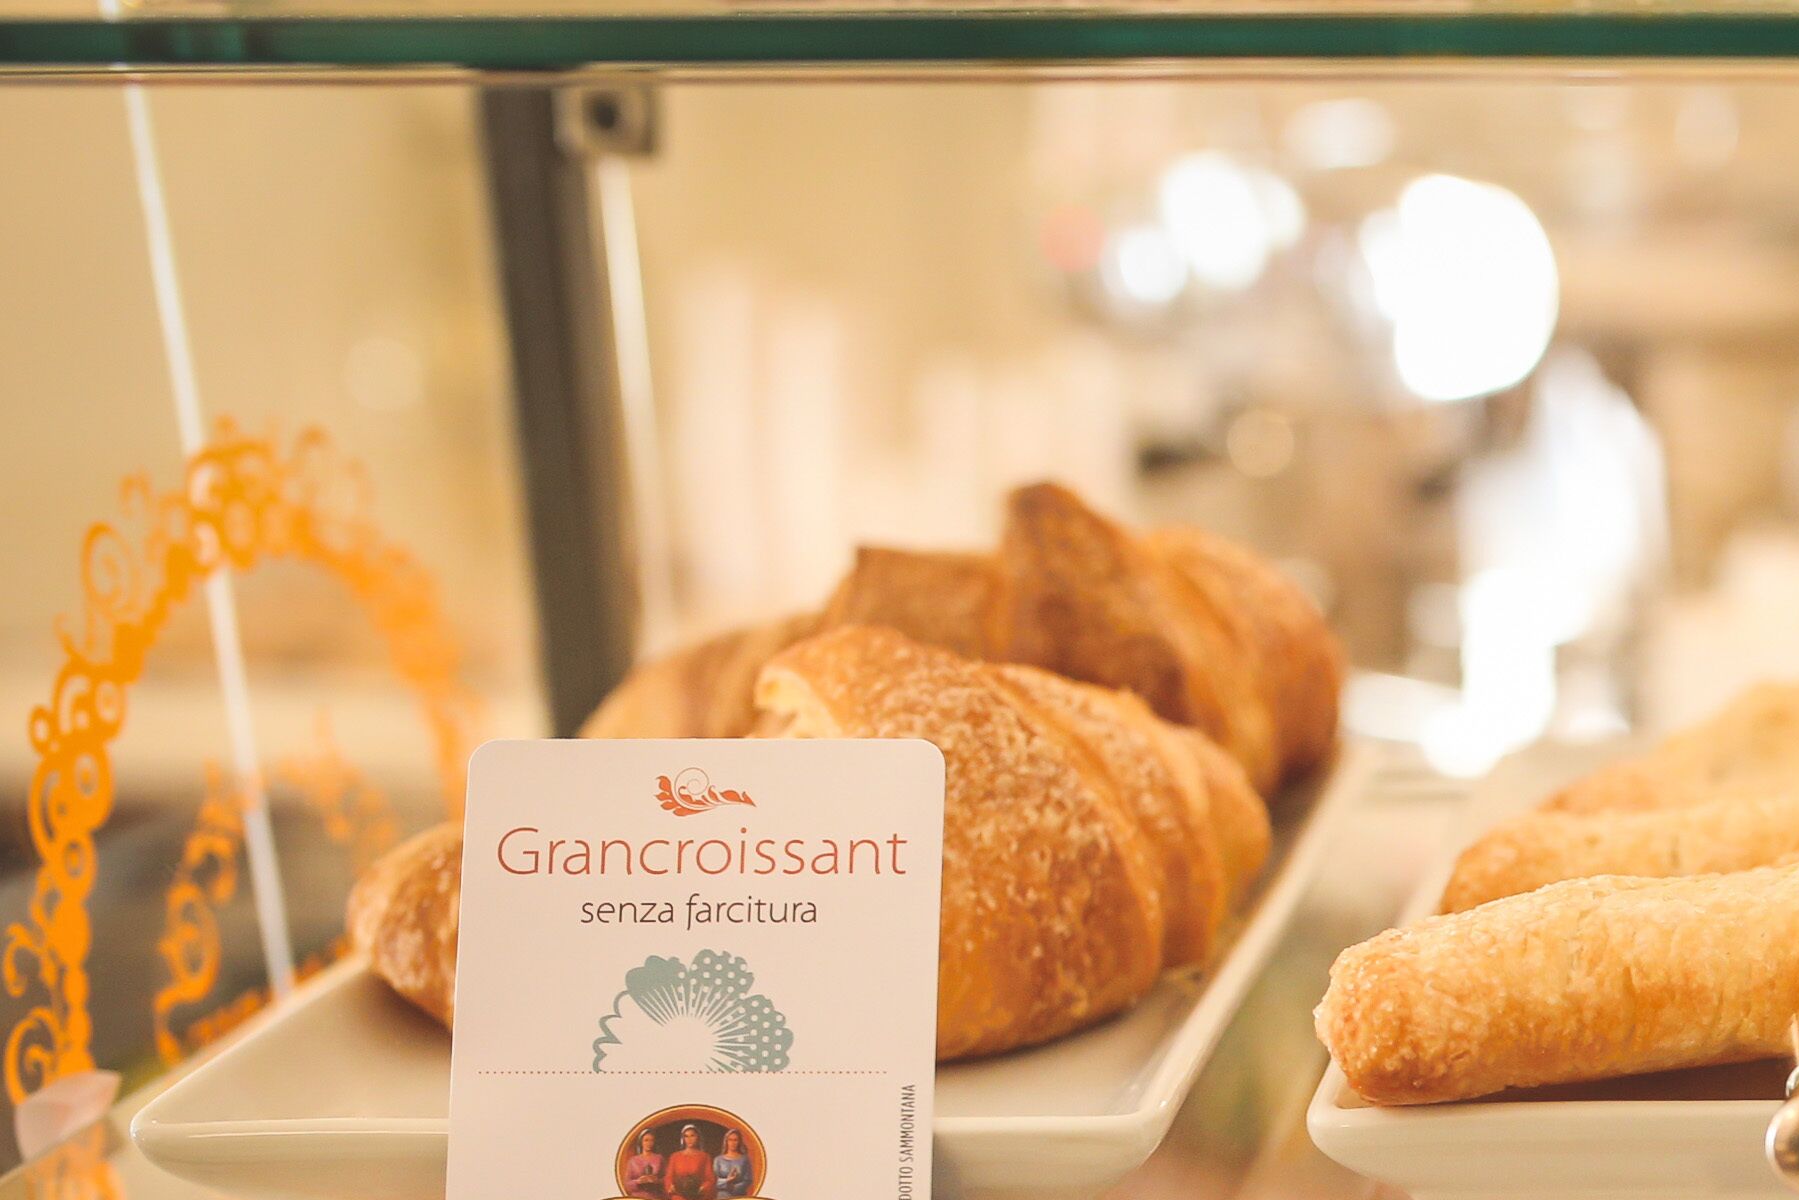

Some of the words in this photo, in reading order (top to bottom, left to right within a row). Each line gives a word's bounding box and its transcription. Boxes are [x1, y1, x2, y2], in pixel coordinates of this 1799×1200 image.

[496, 826, 909, 877] Grancroissant
[580, 899, 676, 925] senza
[685, 892, 819, 931] farcitura
[898, 1084, 916, 1163] SAMMONTANA
